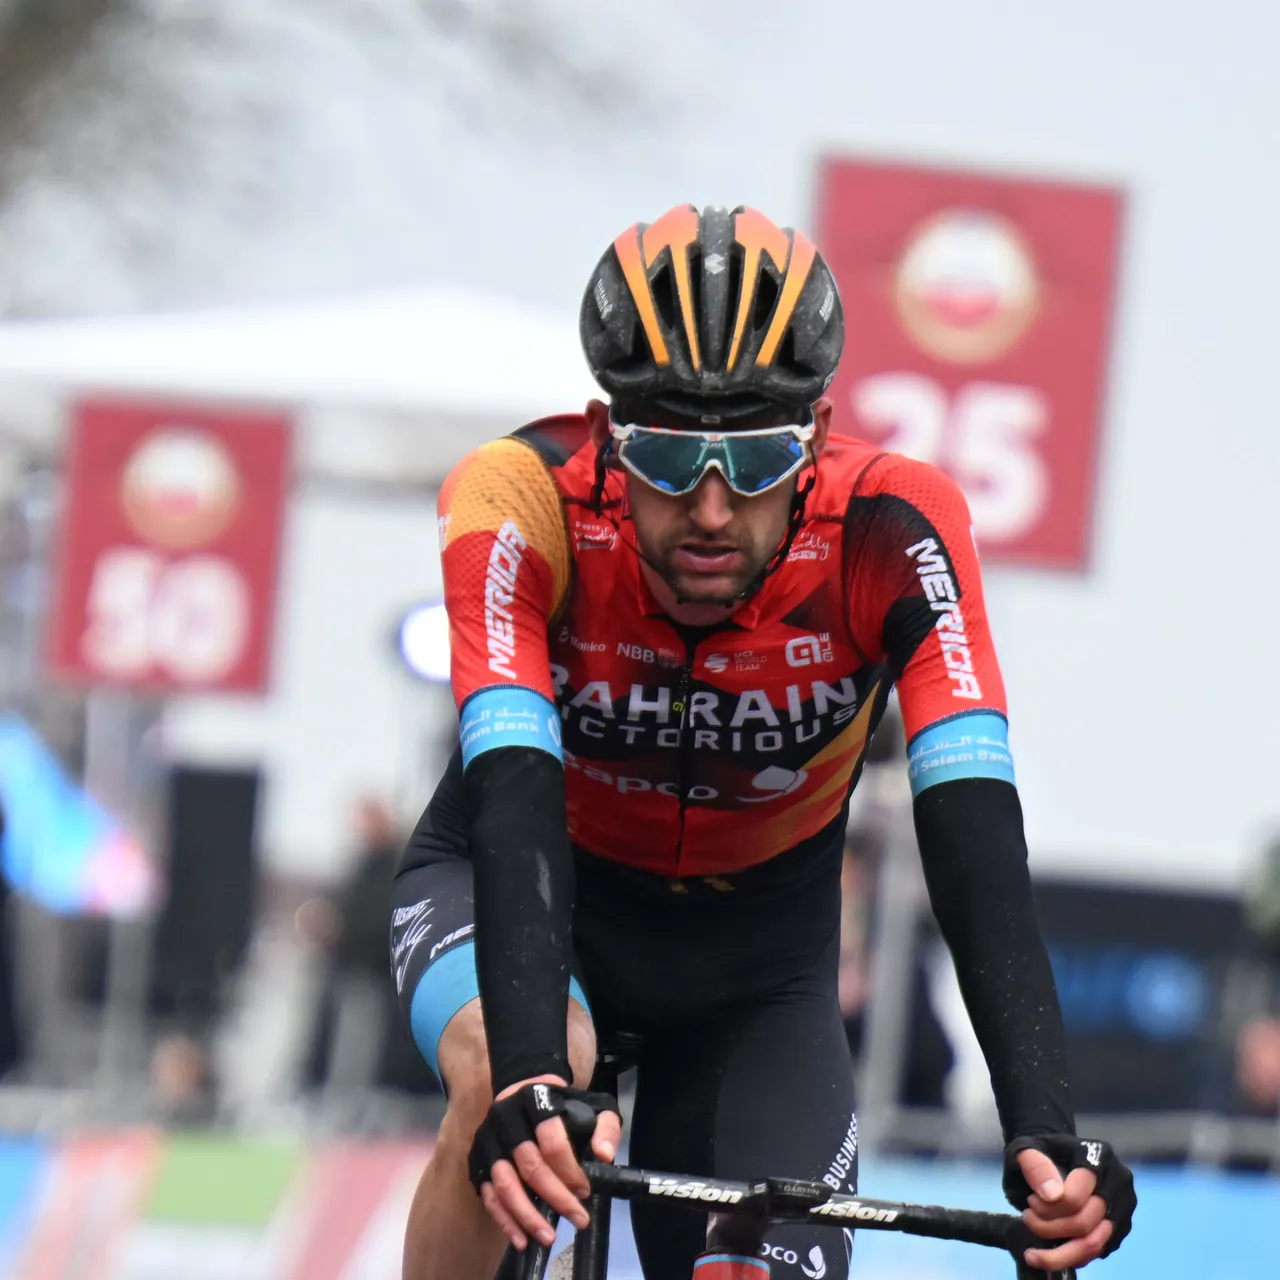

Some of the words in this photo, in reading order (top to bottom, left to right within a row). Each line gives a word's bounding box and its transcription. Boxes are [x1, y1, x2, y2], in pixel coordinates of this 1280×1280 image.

[83, 548, 250, 681] 50
[485, 519, 527, 680] MERIDA
[905, 537, 983, 700] MERIDA
[616, 642, 655, 663] NBB
[494, 720, 539, 733] Bank
[562, 703, 857, 752] ICTORIOUS
[921, 753, 973, 773] Salam
[648, 1176, 744, 1205] Vision
